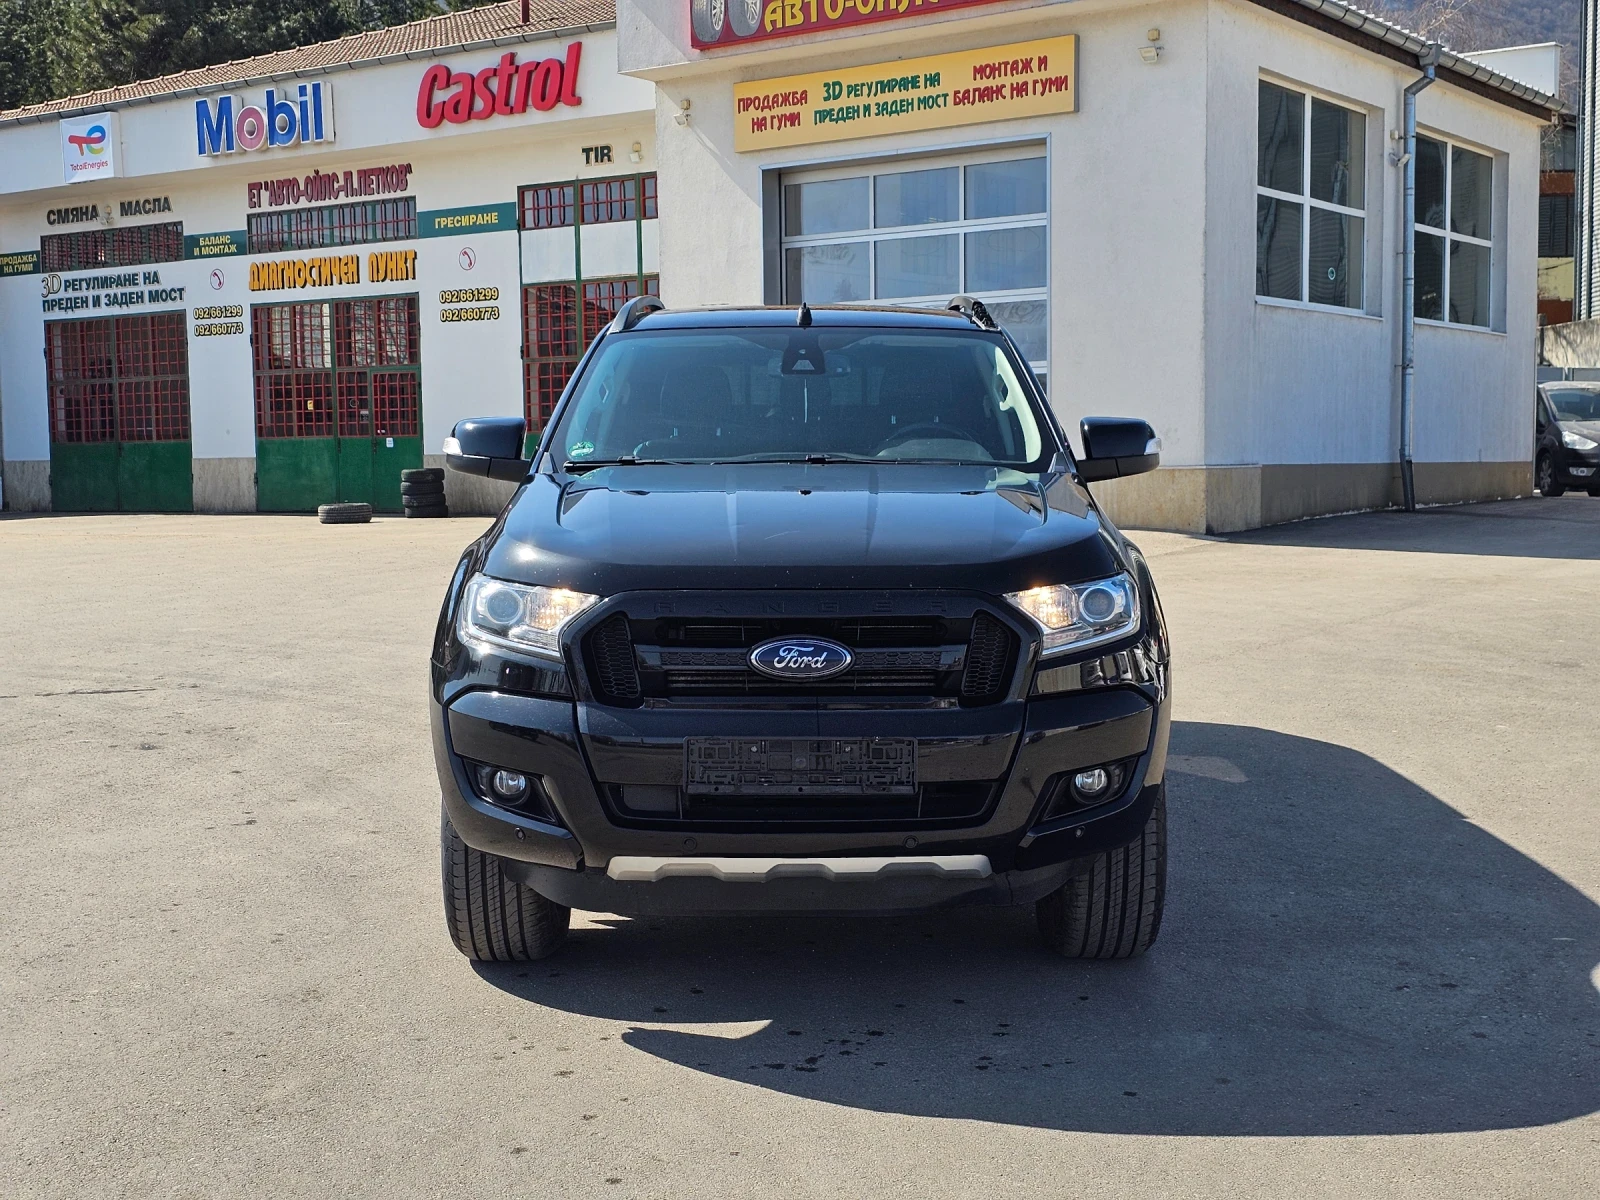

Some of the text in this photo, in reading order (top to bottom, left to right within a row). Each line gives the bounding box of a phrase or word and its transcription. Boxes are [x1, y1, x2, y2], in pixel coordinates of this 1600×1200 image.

[972, 55, 1048, 82] МОНТАЖ И
[417, 41, 582, 129] Castrol
[823, 71, 941, 102] 3D РЕГУЛИРАНЕ НА
[953, 75, 1069, 106] БАЛАНС НА ГУМИ
[737, 89, 808, 114] ПРОДАЖБА
[814, 93, 949, 125] ПРЕДЕН И ЗАДЕН МОСТ
[195, 81, 328, 157] Mobil
[751, 111, 801, 133] НА ГУМИ
[70, 159, 108, 172] TotalEnergies
[581, 145, 613, 165] TIR
[247, 182, 262, 208] ЕТ
[46, 196, 172, 226] СМЯНА МАСЛА
[435, 212, 498, 229] ГРЕСИРАНЕ
[193, 243, 237, 256] И МОНТАЖ
[200, 234, 231, 245] БАЛАНС
[4, 263, 33, 274] НА ГУМИ
[249, 249, 417, 291] ДИАГНОСТИЧЕН ПУНКТ
[41, 270, 160, 298] 3D РЕГУЛИРАНЕ НА
[439, 287, 499, 304] 092/661299
[42, 287, 185, 314] ПРЕДЕН И ЗАДЕН МОСТ
[193, 305, 243, 320] 092/661299
[440, 306, 500, 323] 092/660773
[194, 322, 244, 337] 092/660773
[773, 645, 828, 669] Ford
